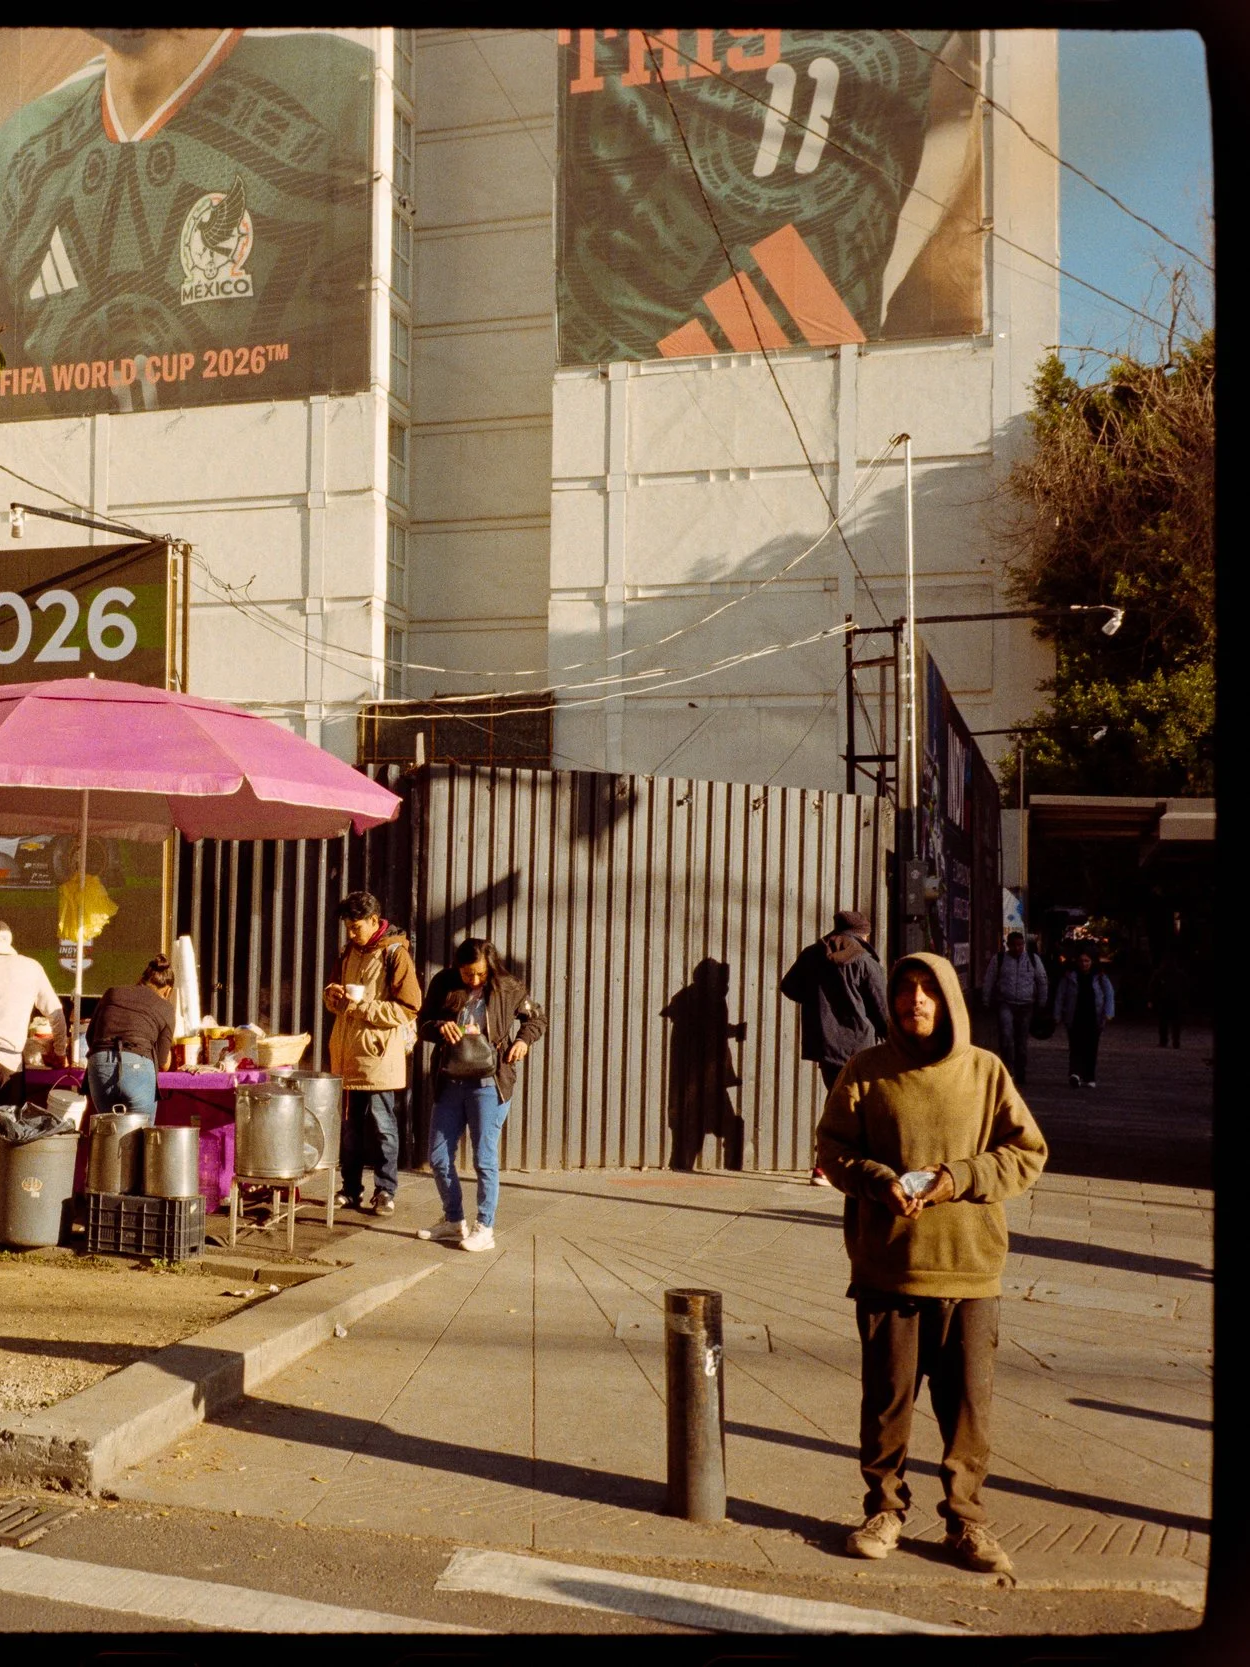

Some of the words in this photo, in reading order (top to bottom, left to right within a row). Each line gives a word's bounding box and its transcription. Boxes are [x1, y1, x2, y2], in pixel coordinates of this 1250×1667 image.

[183, 280, 250, 302] MÉXICO
[0, 366, 47, 397] FIFA
[52, 358, 138, 393] WORLD
[145, 352, 196, 384] CUP
